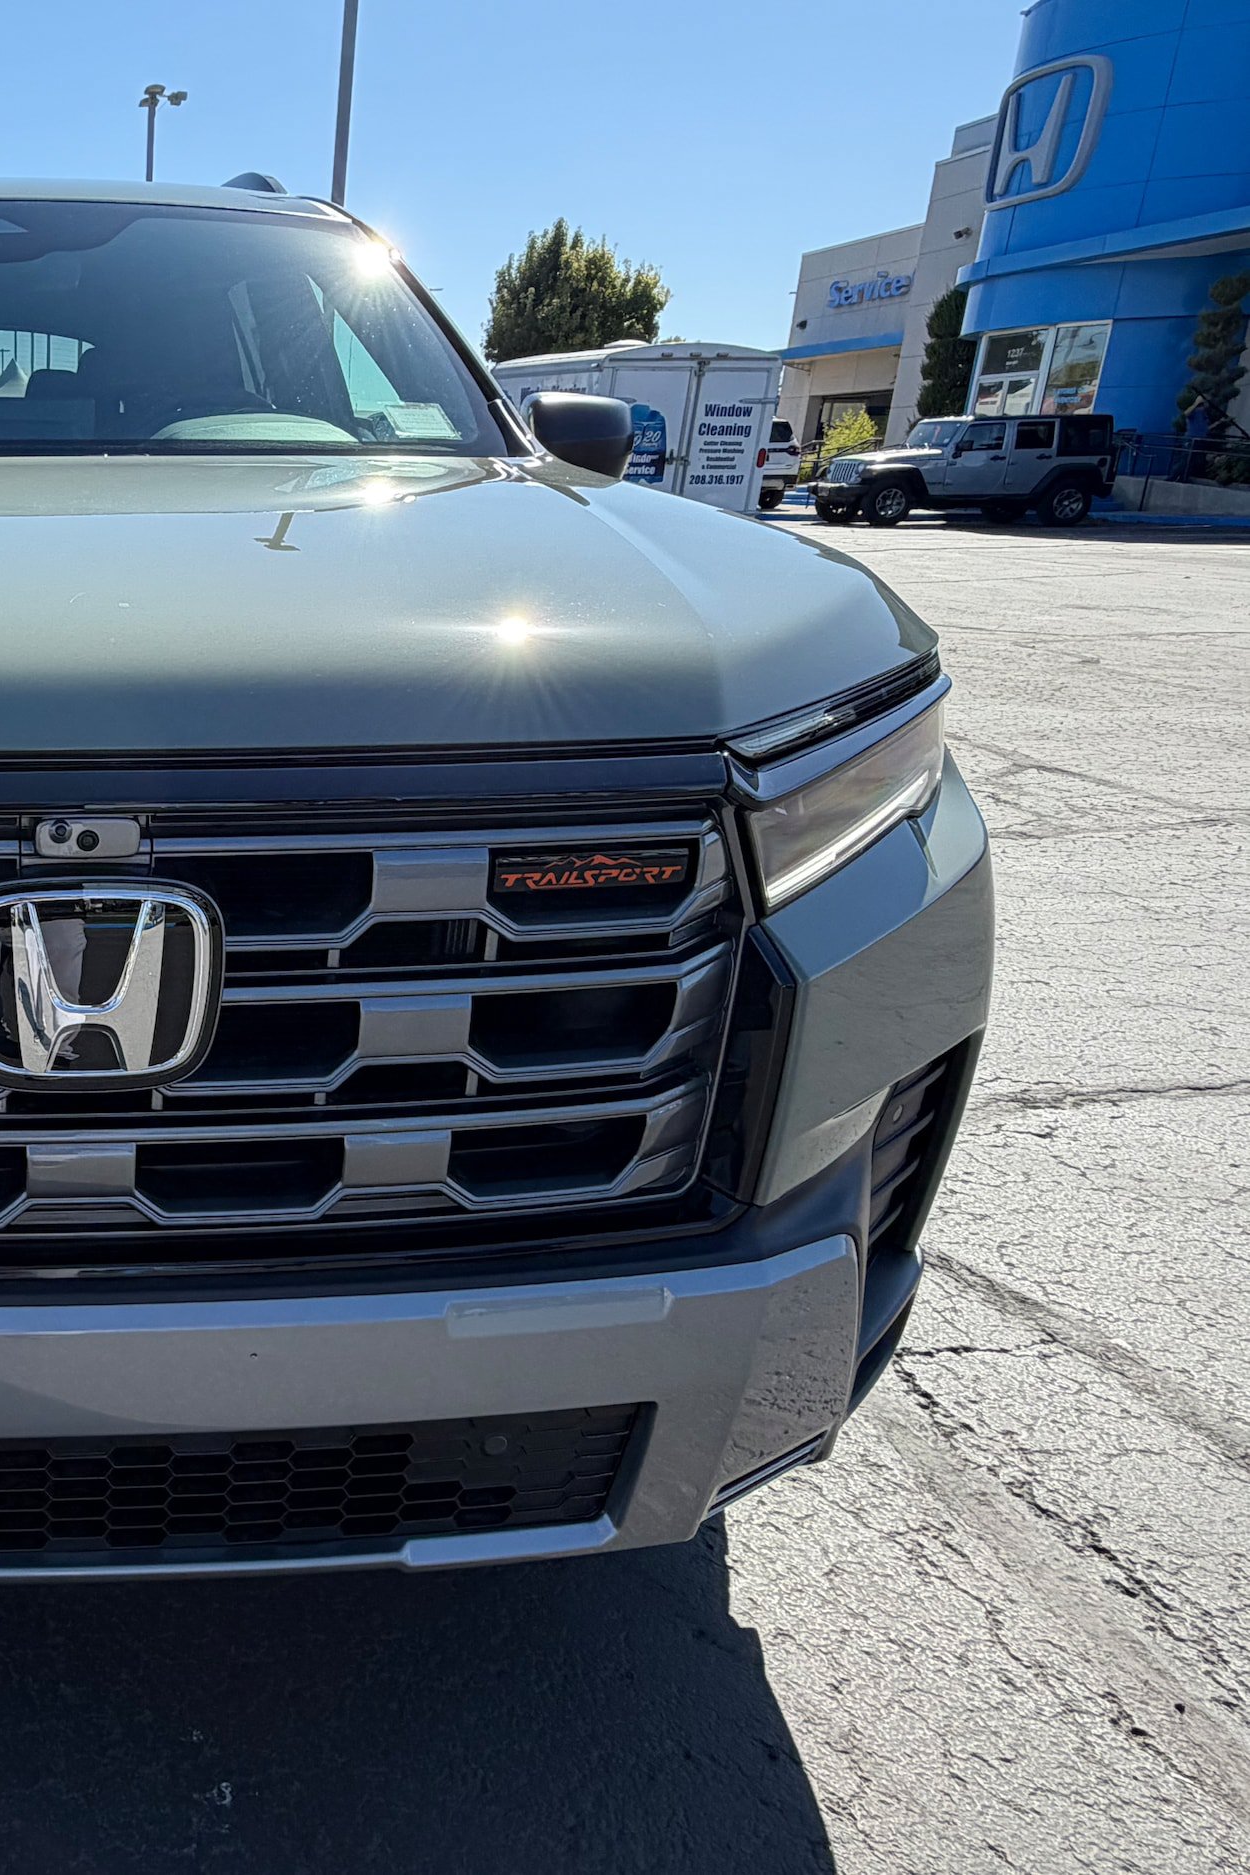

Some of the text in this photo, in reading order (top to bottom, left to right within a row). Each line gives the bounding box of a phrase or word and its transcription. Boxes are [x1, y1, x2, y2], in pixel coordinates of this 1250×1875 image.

[828, 271, 911, 308] Service
[704, 403, 753, 417] Window
[644, 430, 662, 443] 20
[698, 422, 752, 438] Cleaning
[689, 474, 745, 485] 208.316.1917
[500, 865, 682, 890] TRAILSPORT
